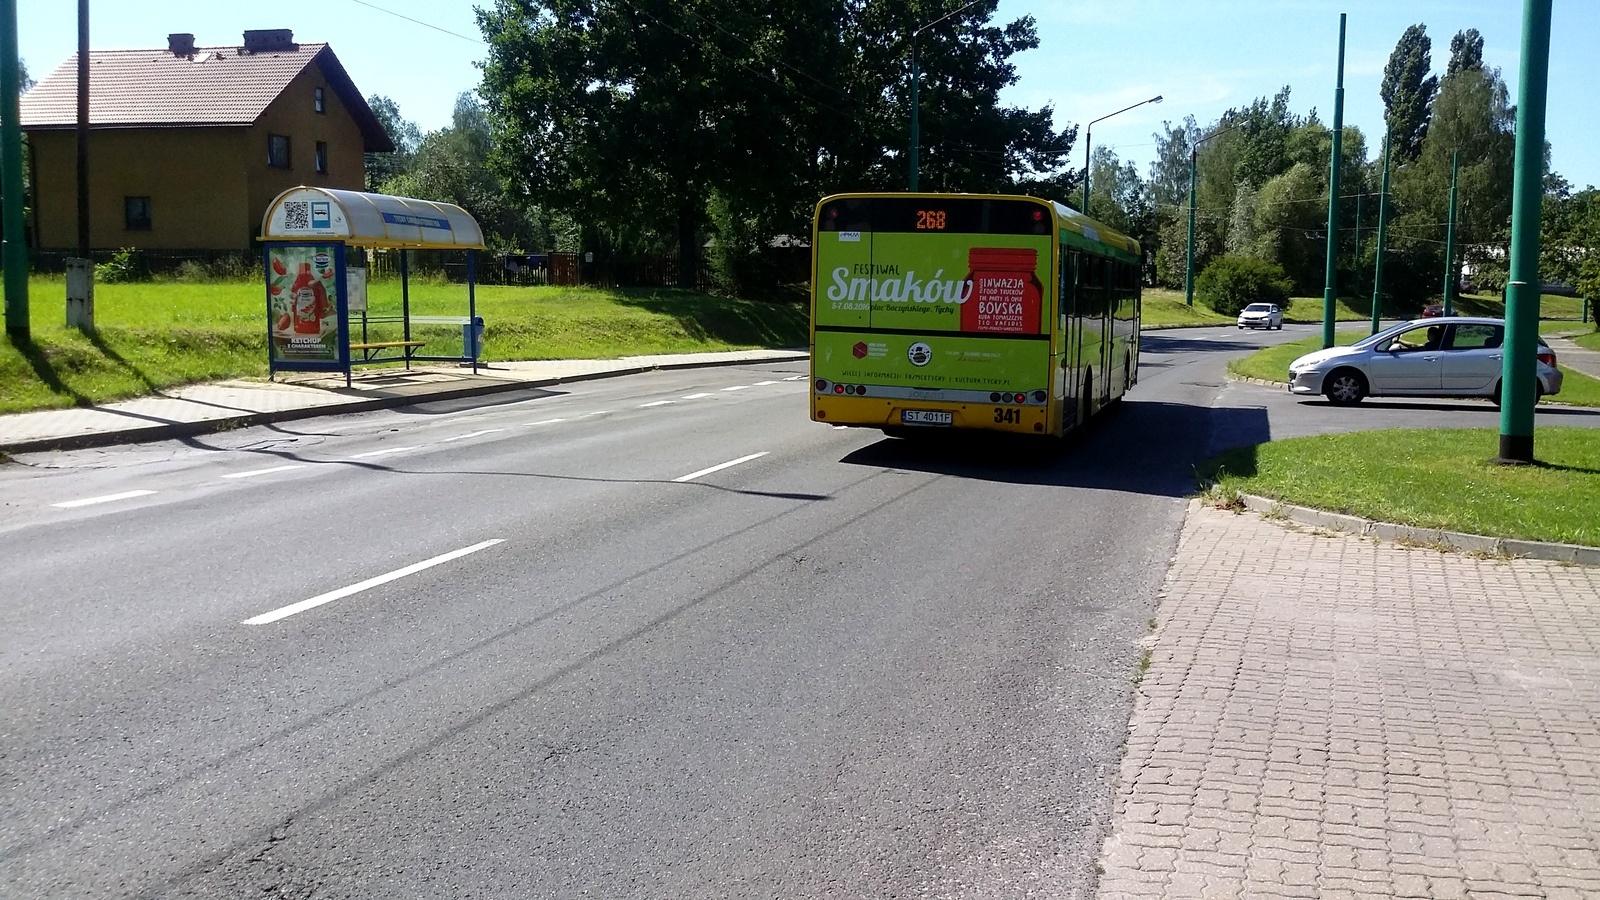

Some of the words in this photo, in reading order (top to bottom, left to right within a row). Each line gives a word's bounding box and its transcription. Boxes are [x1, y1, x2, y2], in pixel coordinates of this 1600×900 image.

[917, 210, 946, 229] 268
[853, 263, 900, 276] FESTIWAL
[827, 267, 973, 305] Smaków
[983, 278, 1024, 289] INWAZJA
[934, 305, 955, 315] Tychy
[979, 302, 1023, 315] BOVSKA
[907, 412, 920, 421] ST
[923, 413, 951, 422] 4011F
[994, 408, 1021, 424] 341
